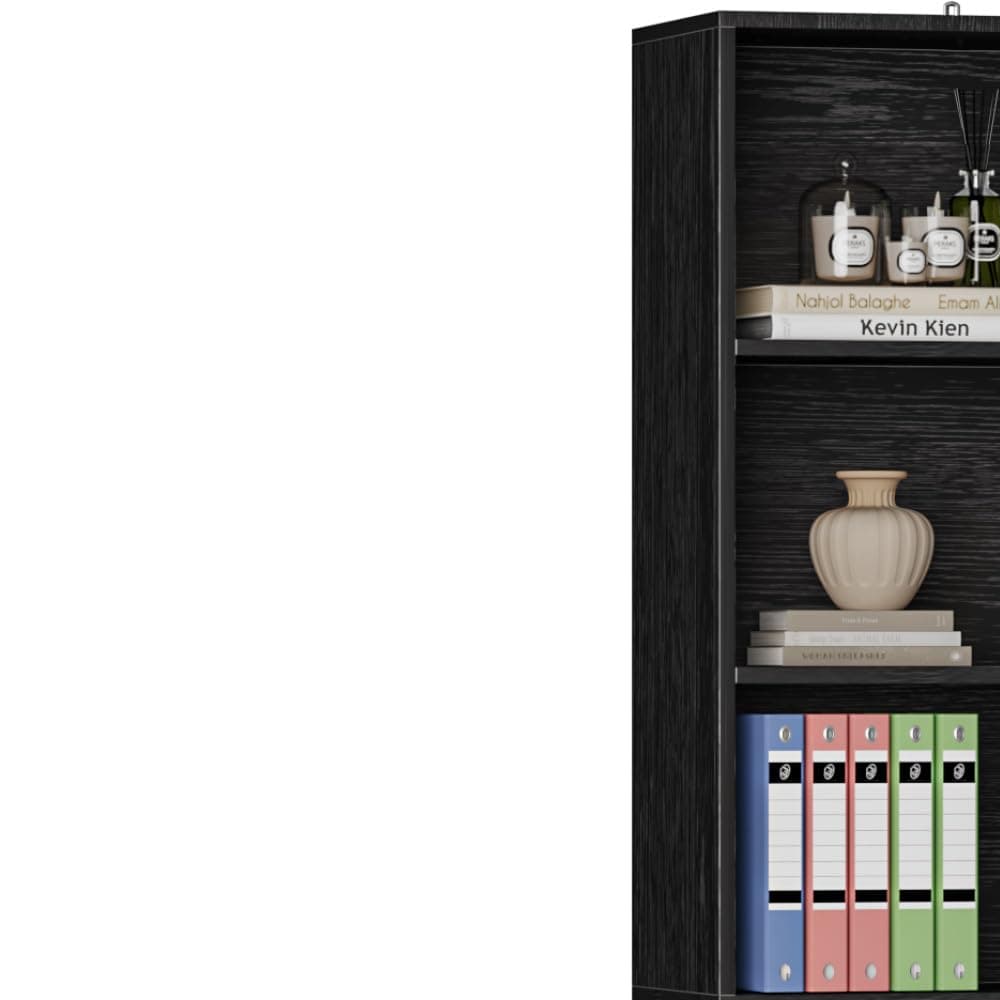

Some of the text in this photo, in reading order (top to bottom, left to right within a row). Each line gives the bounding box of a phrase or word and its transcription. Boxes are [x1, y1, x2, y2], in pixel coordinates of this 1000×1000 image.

[796, 293, 911, 314] Nahjol Balaghe
[938, 295, 981, 309] Emam
[861, 319, 970, 336] Kevin Kien
